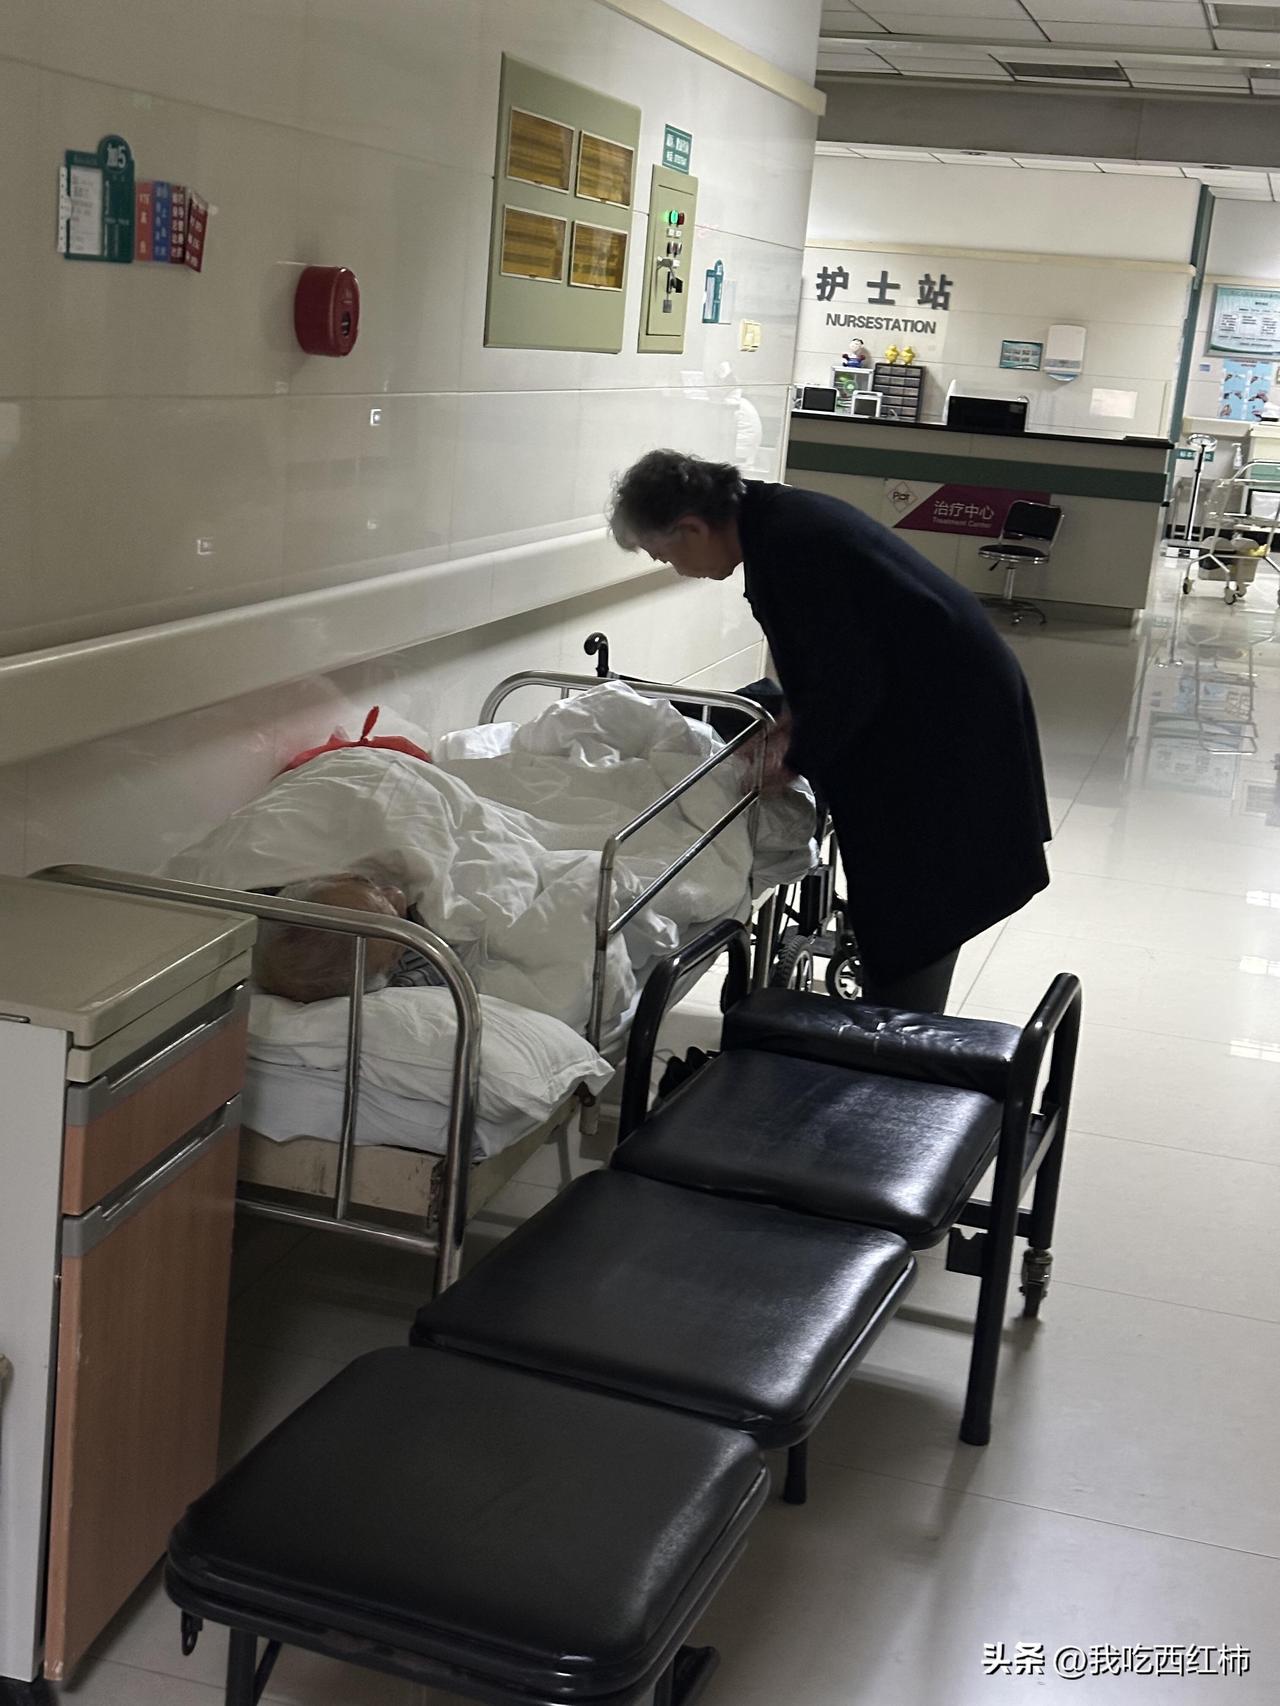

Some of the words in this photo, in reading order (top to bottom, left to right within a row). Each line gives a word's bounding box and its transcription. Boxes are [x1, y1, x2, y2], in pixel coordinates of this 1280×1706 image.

[816, 266, 953, 310] 护士站
[826, 313, 936, 334] NURSESTATION
[933, 500, 994, 520] 治疗中心
